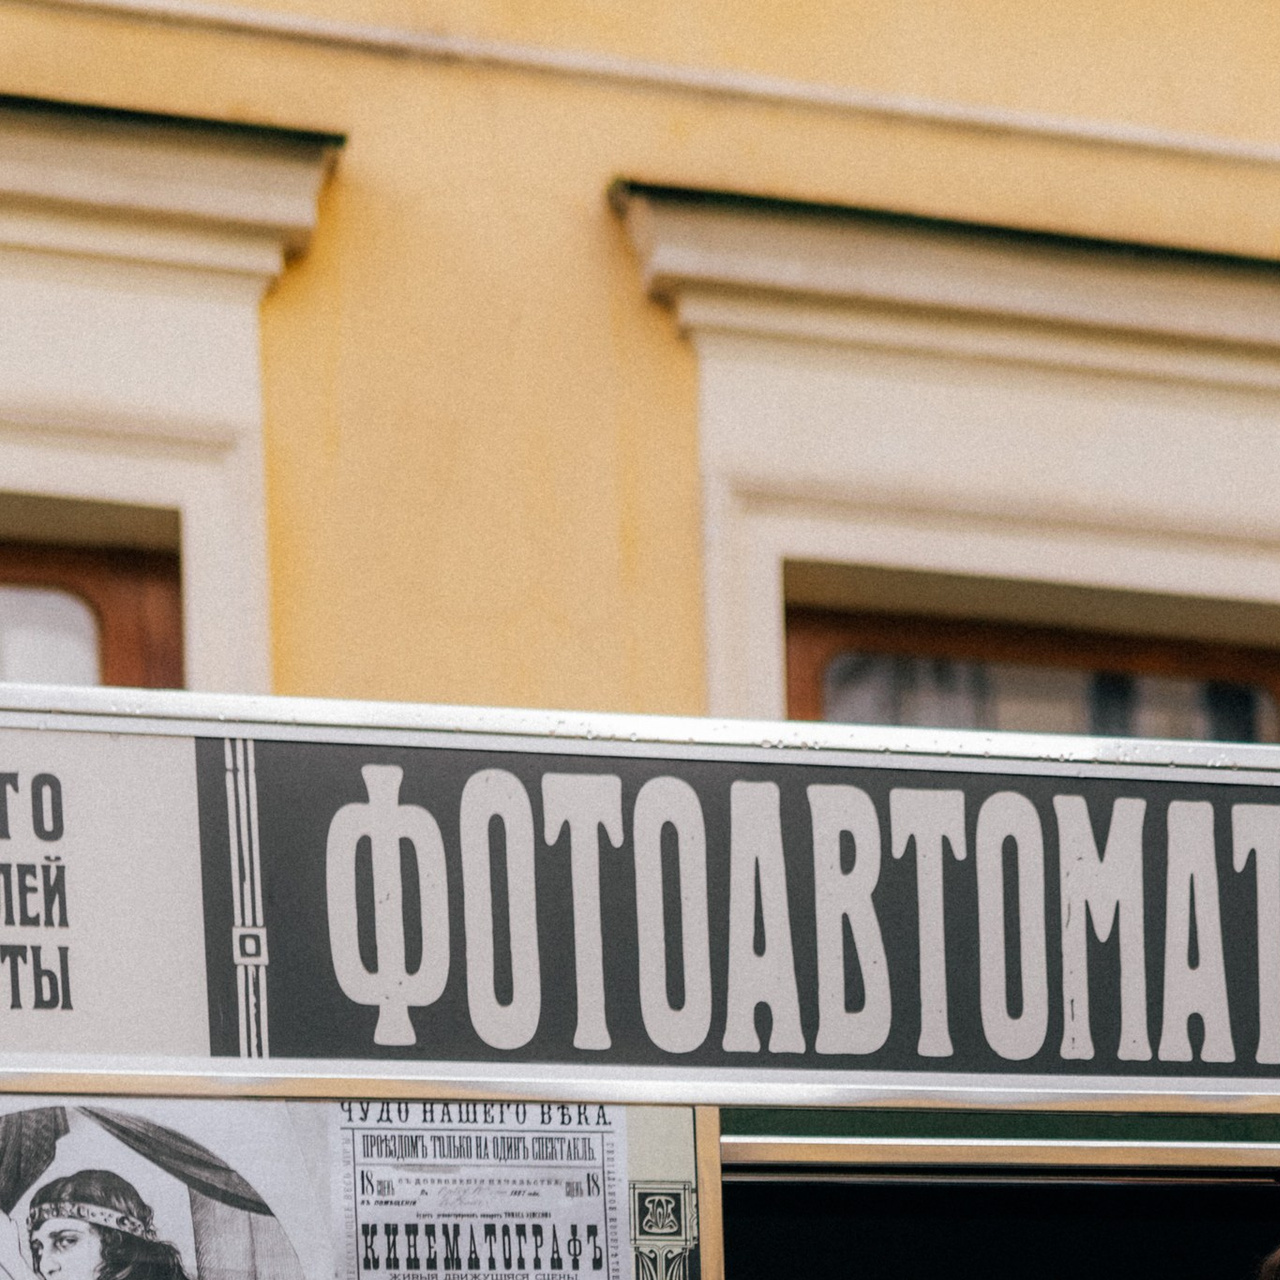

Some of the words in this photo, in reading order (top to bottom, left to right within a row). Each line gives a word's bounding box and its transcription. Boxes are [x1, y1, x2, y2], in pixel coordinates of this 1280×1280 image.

[341, 1101, 410, 1124] ЧУДО
[422, 1101, 527, 1125] НАШЕГО
[430, 1134, 473, 1160] ТОЛЬКО
[475, 1135, 489, 1160] НА
[492, 1135, 529, 1163] ОДИНЪ
[360, 1169, 375, 1196] 18
[586, 1172, 601, 1197] 18
[361, 1222, 604, 1271] КИНЕМАТОГРАФЪ
